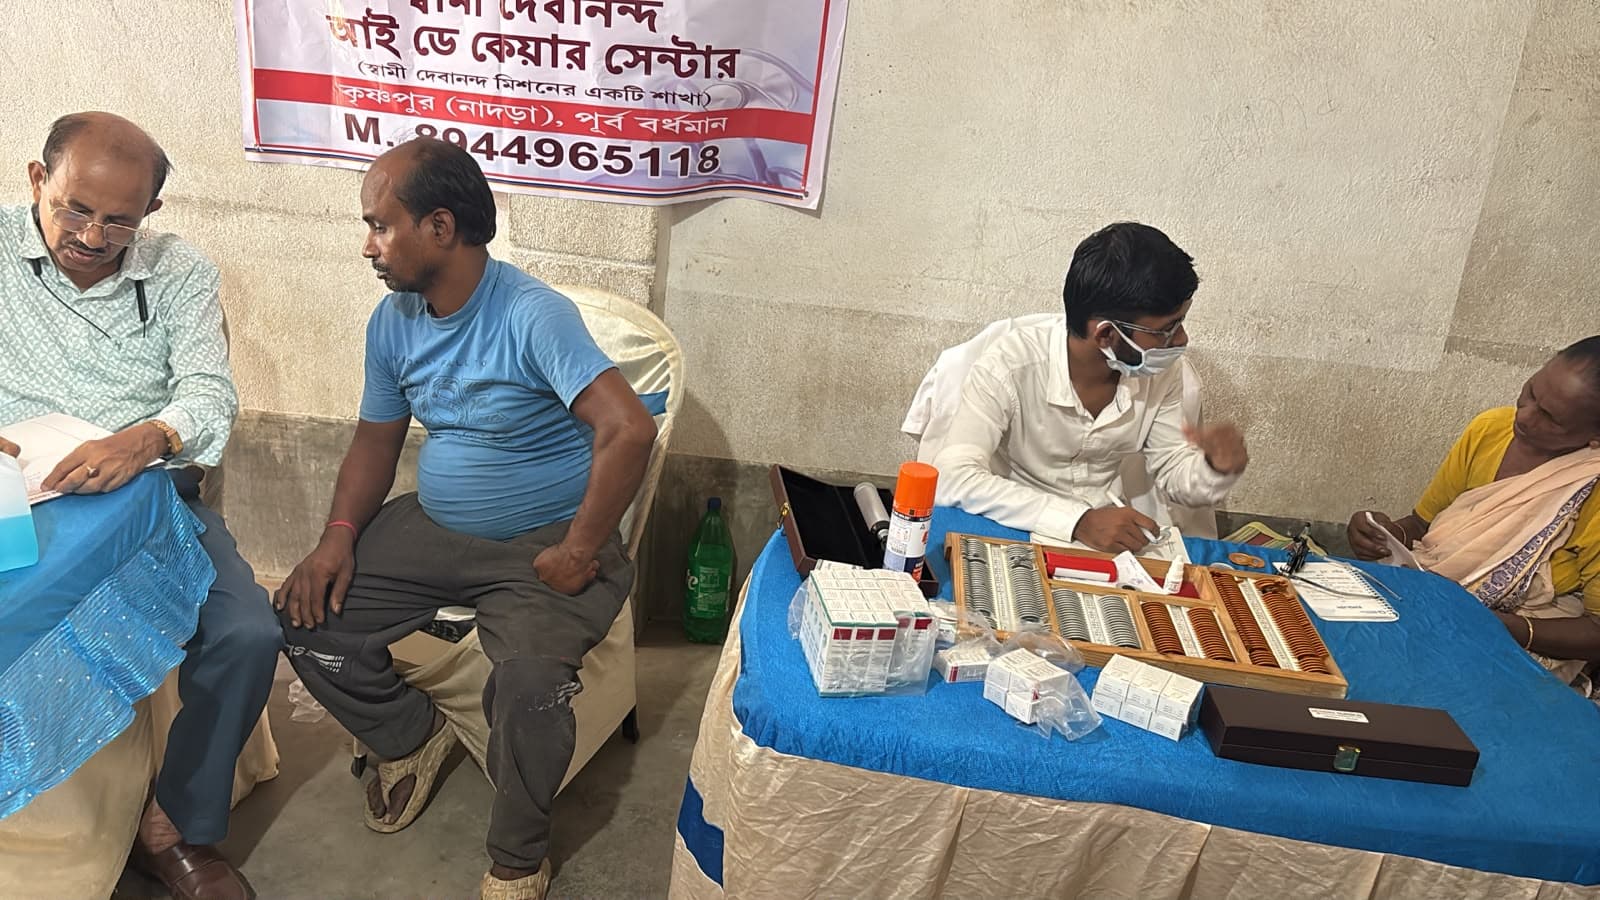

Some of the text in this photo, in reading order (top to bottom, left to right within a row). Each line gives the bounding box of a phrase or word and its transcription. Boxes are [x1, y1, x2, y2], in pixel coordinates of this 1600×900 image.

[326, 8, 401, 60] আই
[413, 26, 460, 56] ডে
[471, 32, 591, 71] কেয়ার
[605, 35, 741, 79] সেন্টার
[358, 61, 712, 108] (স্বামী দেবানন্দ মিশনের একটি শাখা)
[337, 83, 436, 115] কৃষ্ণপুর
[574, 109, 632, 136] পূর্ব
[635, 114, 728, 137] বর্ধমান
[344, 113, 395, 147] M.
